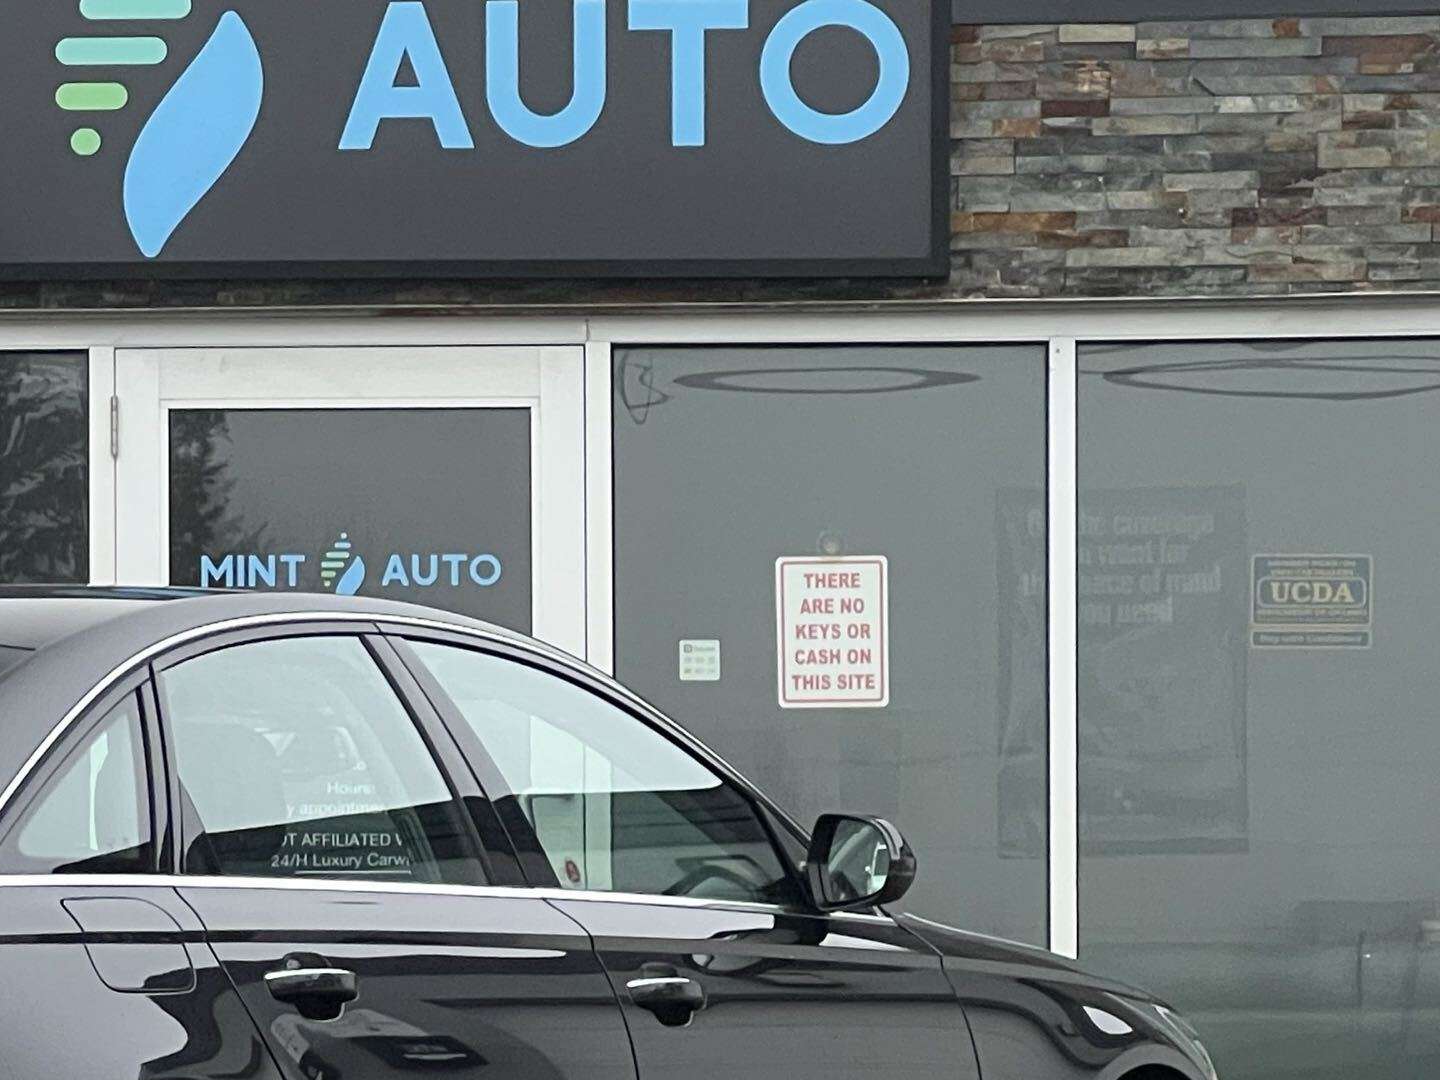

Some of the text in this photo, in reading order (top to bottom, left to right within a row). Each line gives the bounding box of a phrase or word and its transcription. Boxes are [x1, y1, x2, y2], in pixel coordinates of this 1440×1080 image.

[337, 0, 910, 150] AUTO
[200, 553, 502, 588] MINT AUTO
[803, 572, 861, 589] THERE
[1269, 581, 1355, 603] UCDA
[799, 597, 865, 615] ARE NO
[795, 622, 872, 640] KEYS OR
[794, 648, 872, 665] CASH ON
[792, 673, 876, 691] THIS SITE
[301, 832, 392, 847] AFFILIATED
[271, 853, 308, 868] 24/H
[312, 853, 363, 869] Luxury
